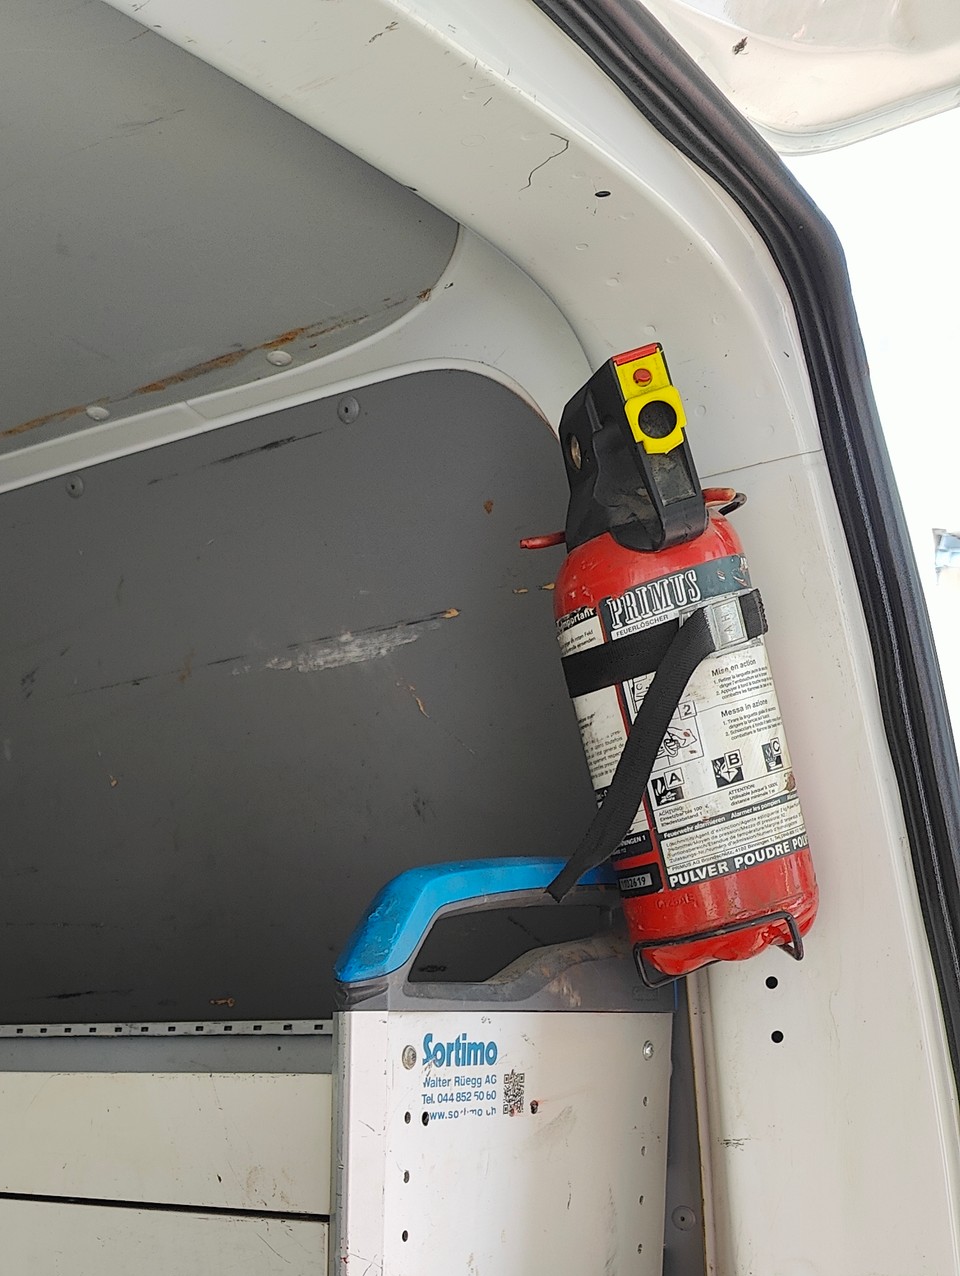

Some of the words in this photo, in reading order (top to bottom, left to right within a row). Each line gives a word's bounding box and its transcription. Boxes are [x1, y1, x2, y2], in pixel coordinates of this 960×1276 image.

[606, 569, 701, 630] PRIMUS
[616, 614, 669, 637] FEUERLÖSCHER
[712, 667, 729, 677] Mise
[730, 663, 739, 671] en
[740, 659, 757, 668] action
[683, 704, 692, 716] 2
[721, 706, 744, 717] Messa
[752, 699, 768, 708] azione
[773, 741, 780, 751] C
[728, 753, 740, 765] B
[669, 772, 681, 785] A
[731, 807, 753, 818] Alarmer
[663, 825, 694, 839] Feuerwehr
[669, 861, 729, 887] PULVER
[734, 841, 791, 869] POUDRE
[422, 1033, 498, 1068] Sortimo
[423, 1076, 451, 1088] Walter
[454, 1075, 482, 1088] Rüegg
[485, 1074, 497, 1085] AG
[422, 1093, 435, 1105] Tel.
[437, 1092, 454, 1103] 044
[456, 1091, 472, 1102] 852
[474, 1091, 485, 1100] 50
[486, 1090, 497, 1100] 60
